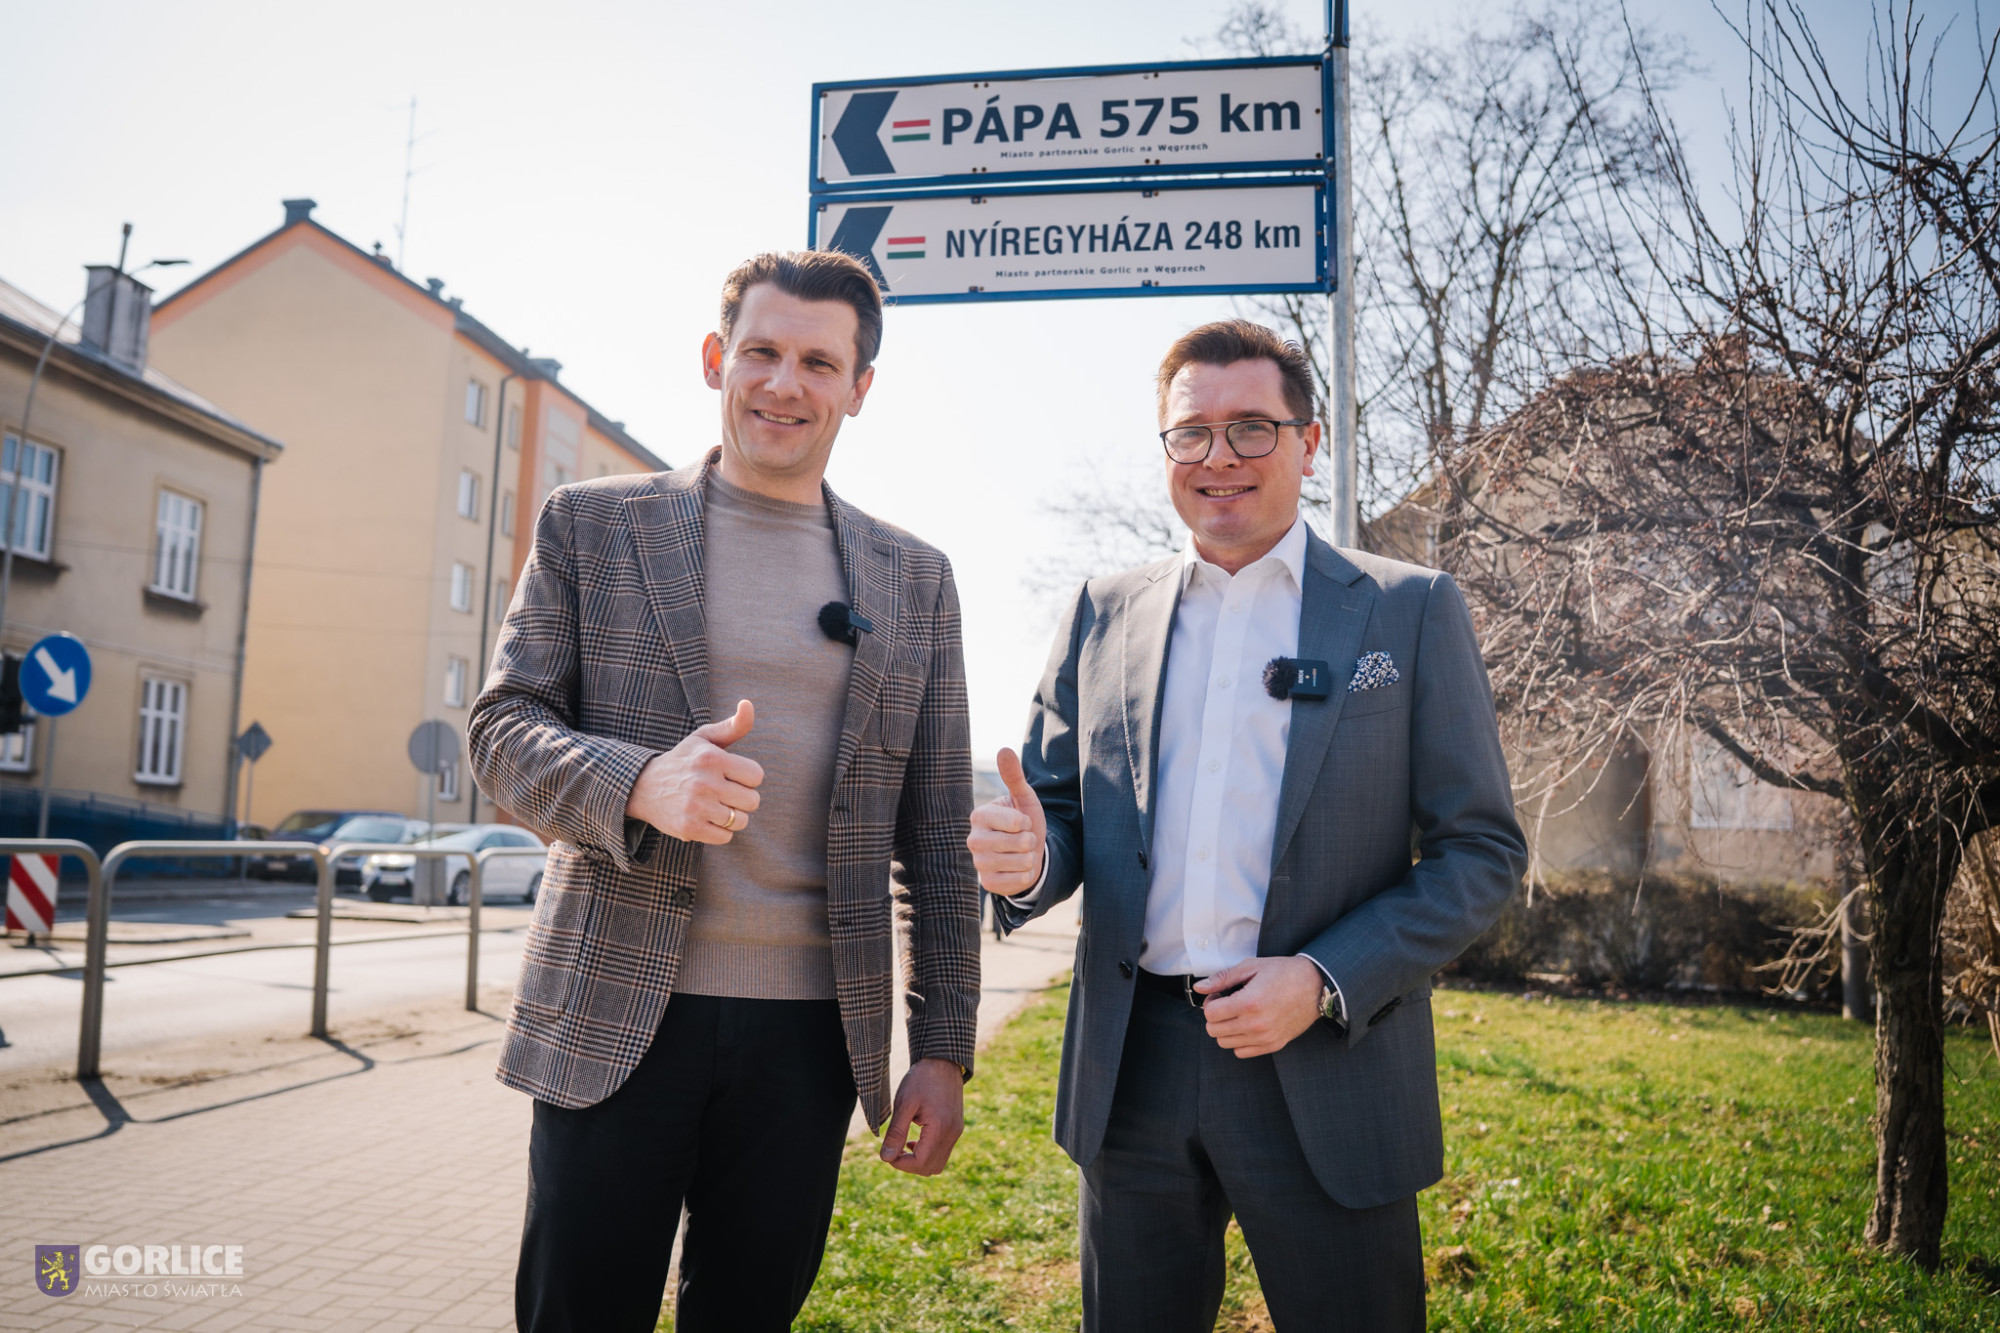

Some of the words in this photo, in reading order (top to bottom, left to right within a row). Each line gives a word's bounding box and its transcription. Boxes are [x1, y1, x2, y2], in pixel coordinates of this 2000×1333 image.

[942, 95, 1082, 146] PÁPA
[1100, 96, 1199, 139] 575
[1220, 93, 1301, 133] km
[1000, 150, 1034, 159] Miasto
[1039, 147, 1099, 159] partnerskie
[1103, 145, 1135, 155] Gorlic
[1140, 145, 1152, 153] na
[1158, 142, 1209, 153] Węgrzech
[945, 215, 1174, 259] NYÍREGYHÁZA
[1184, 219, 1243, 250] 248
[1254, 219, 1301, 249] km
[995, 269, 1030, 279] Miasto
[1034, 266, 1096, 278] partnerskie
[1100, 266, 1132, 275] Gorlic
[1136, 266, 1149, 274] na
[1154, 264, 1206, 274] Węgrzech
